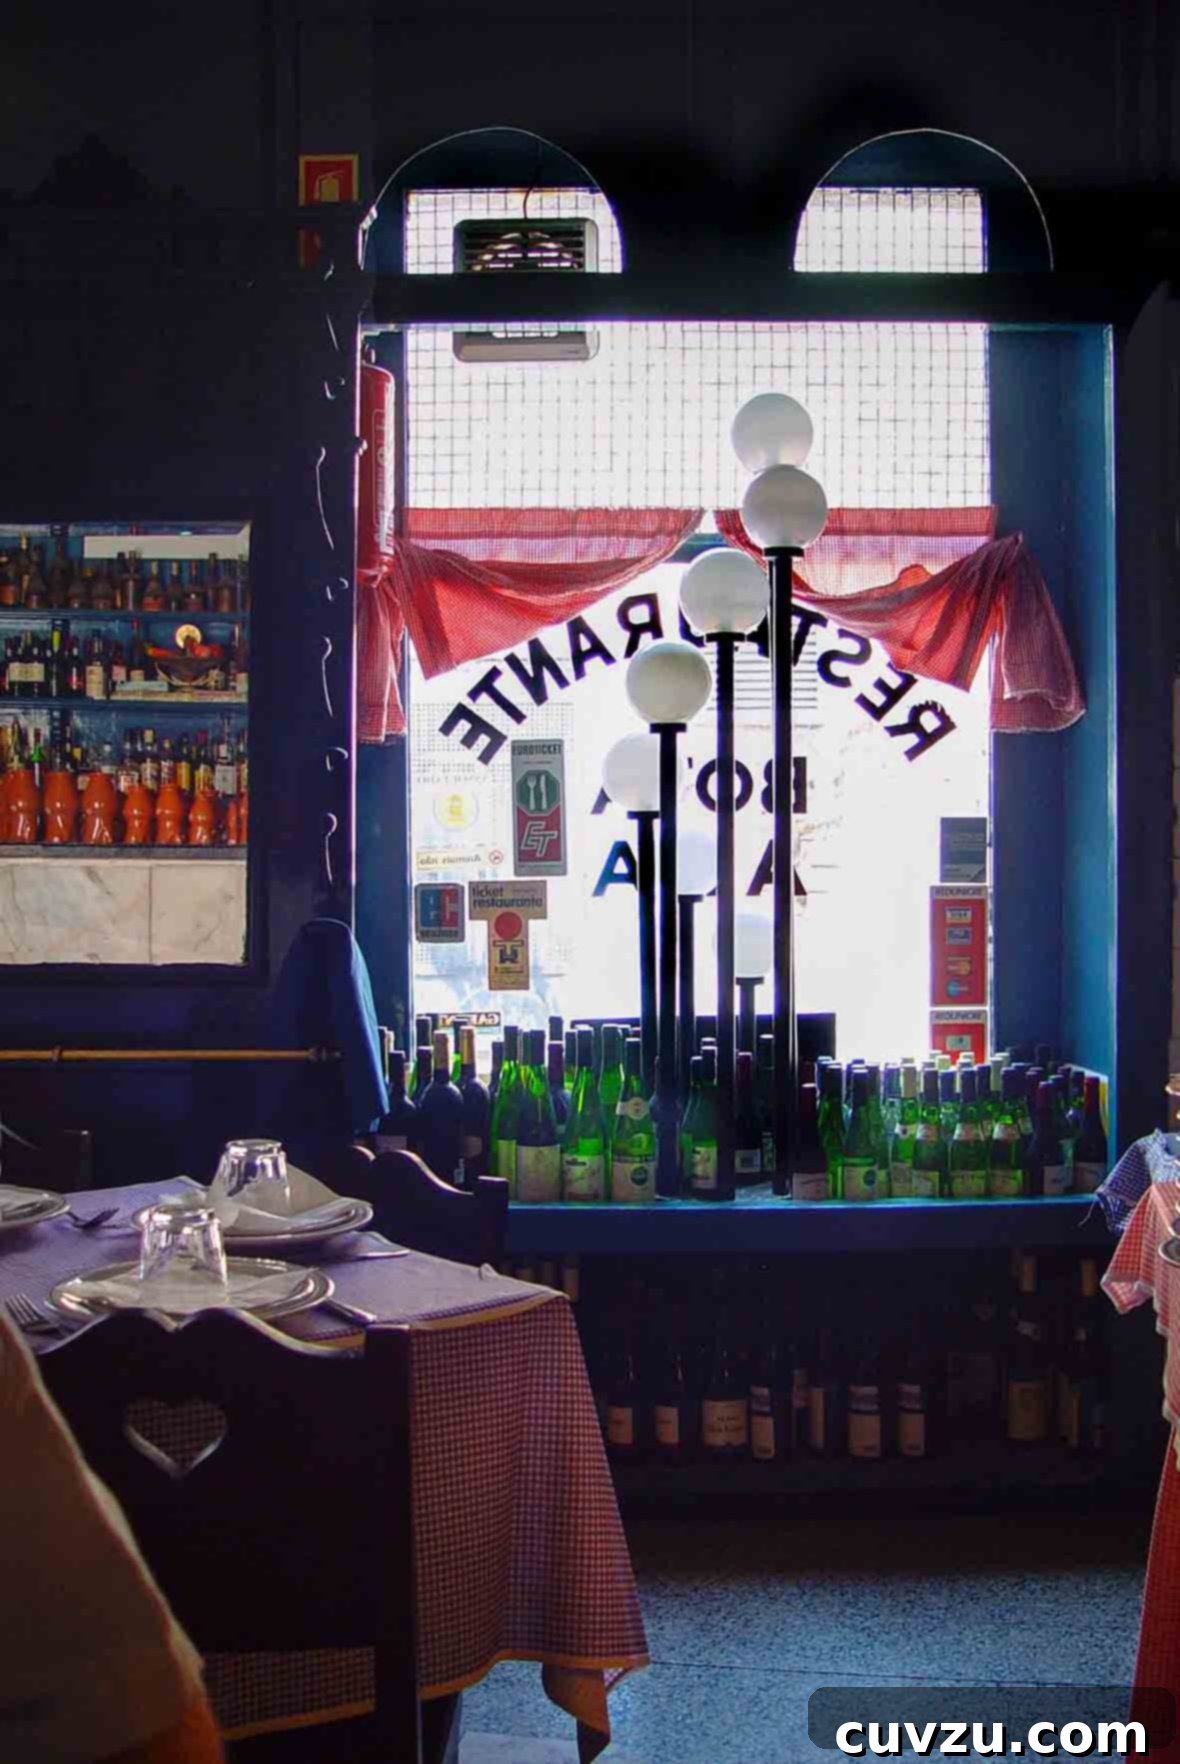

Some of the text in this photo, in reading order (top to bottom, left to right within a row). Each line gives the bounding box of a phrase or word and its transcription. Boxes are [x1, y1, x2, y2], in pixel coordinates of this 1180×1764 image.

[511, 744, 561, 756] EUROTICKET
[520, 820, 558, 858] ET
[472, 885, 504, 898] ticket
